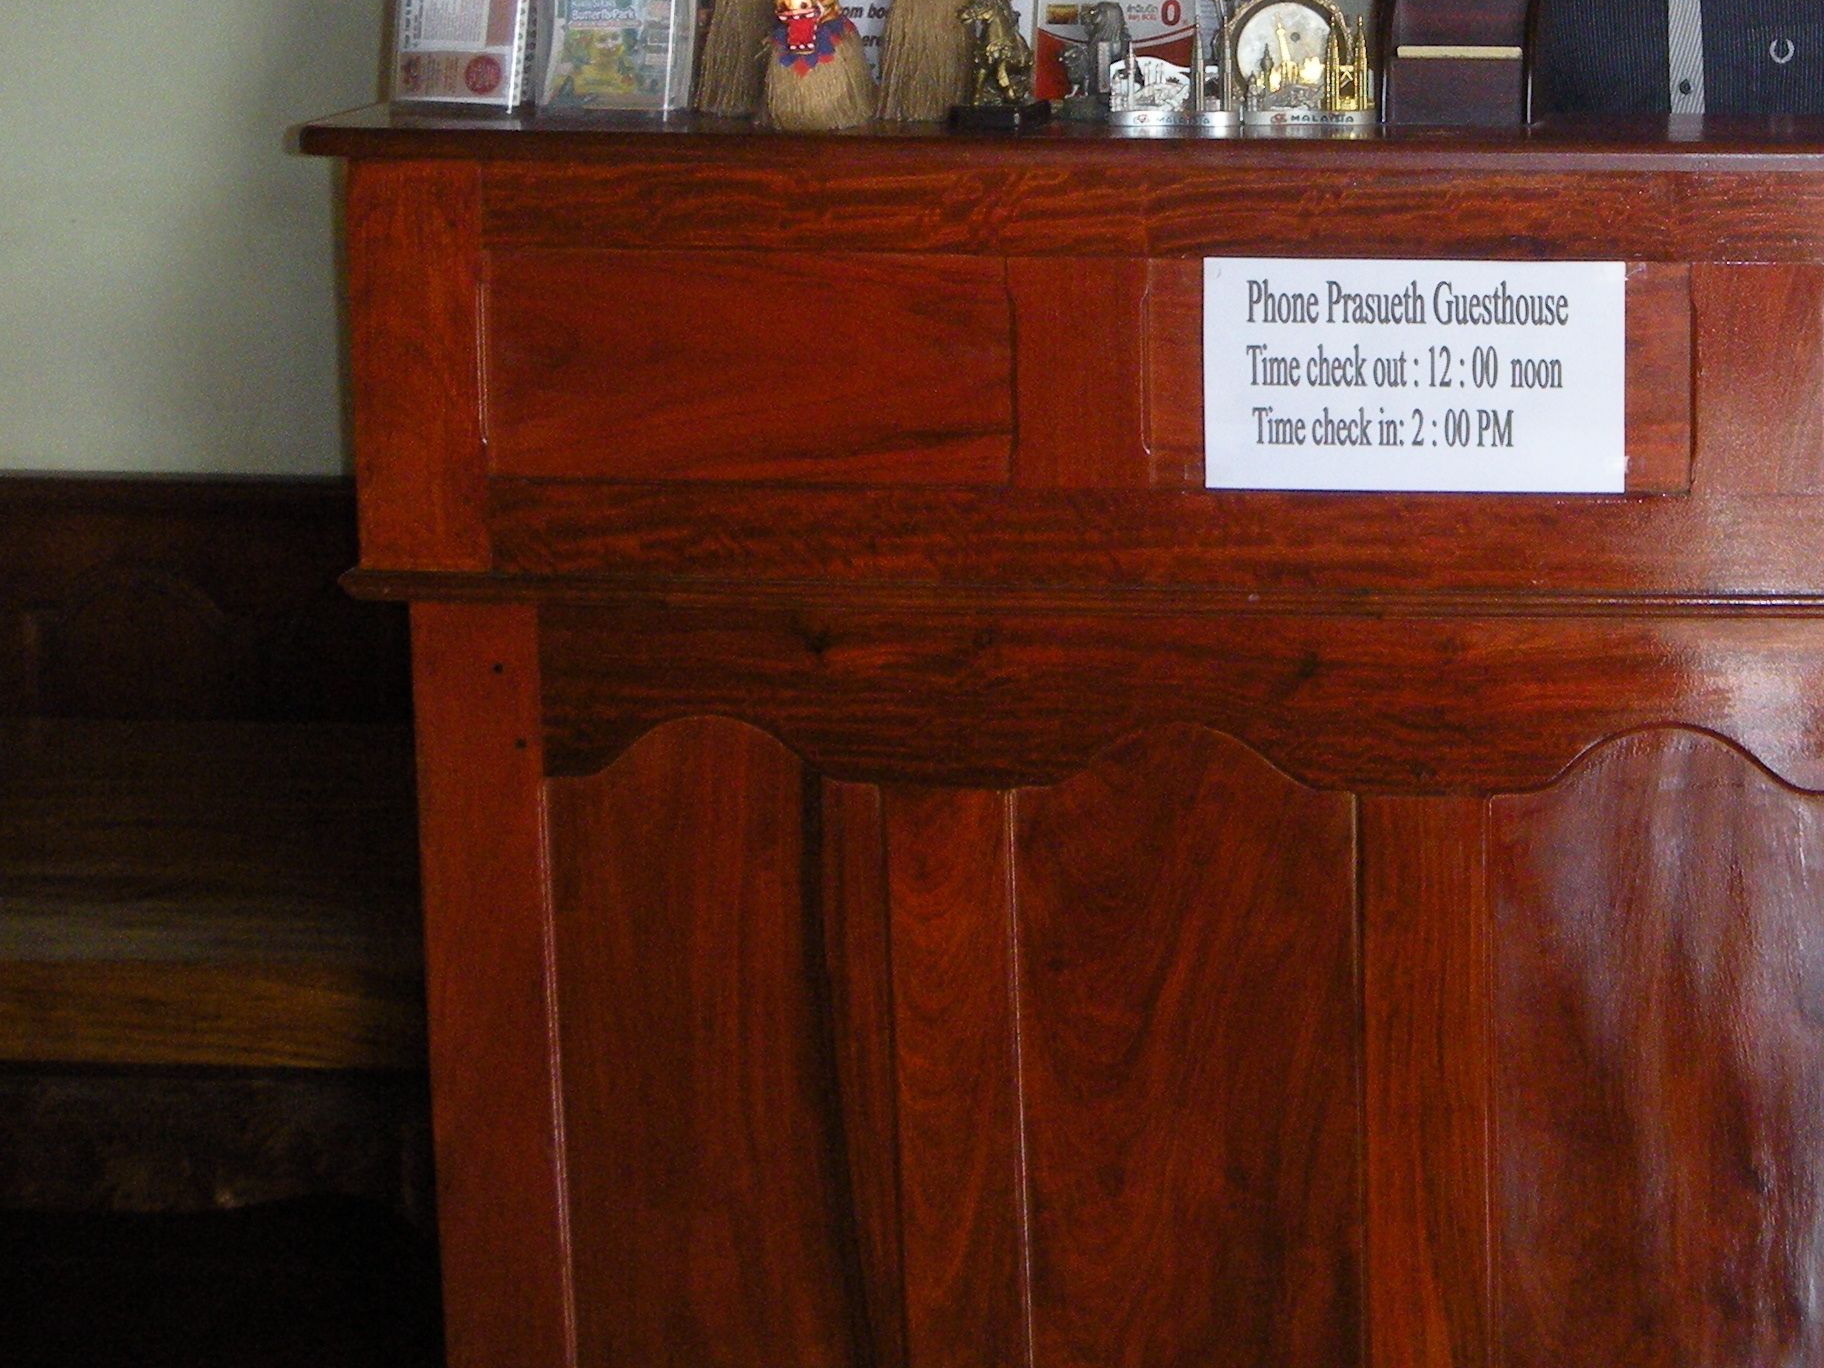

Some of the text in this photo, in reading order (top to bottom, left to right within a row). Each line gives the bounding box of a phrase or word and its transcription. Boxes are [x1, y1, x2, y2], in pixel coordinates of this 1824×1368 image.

[1156, 116, 1210, 126] MALAYSIA
[1290, 114, 1355, 124] MALAYSIA
[1246, 279, 1569, 326] Phone Prasueth Guesthouse
[1247, 343, 1300, 387] Time
[1307, 343, 1367, 387] check
[1510, 358, 1563, 389] noon
[1252, 406, 1306, 446] Time
[1311, 406, 1372, 446] check
[1477, 409, 1514, 448] PM
